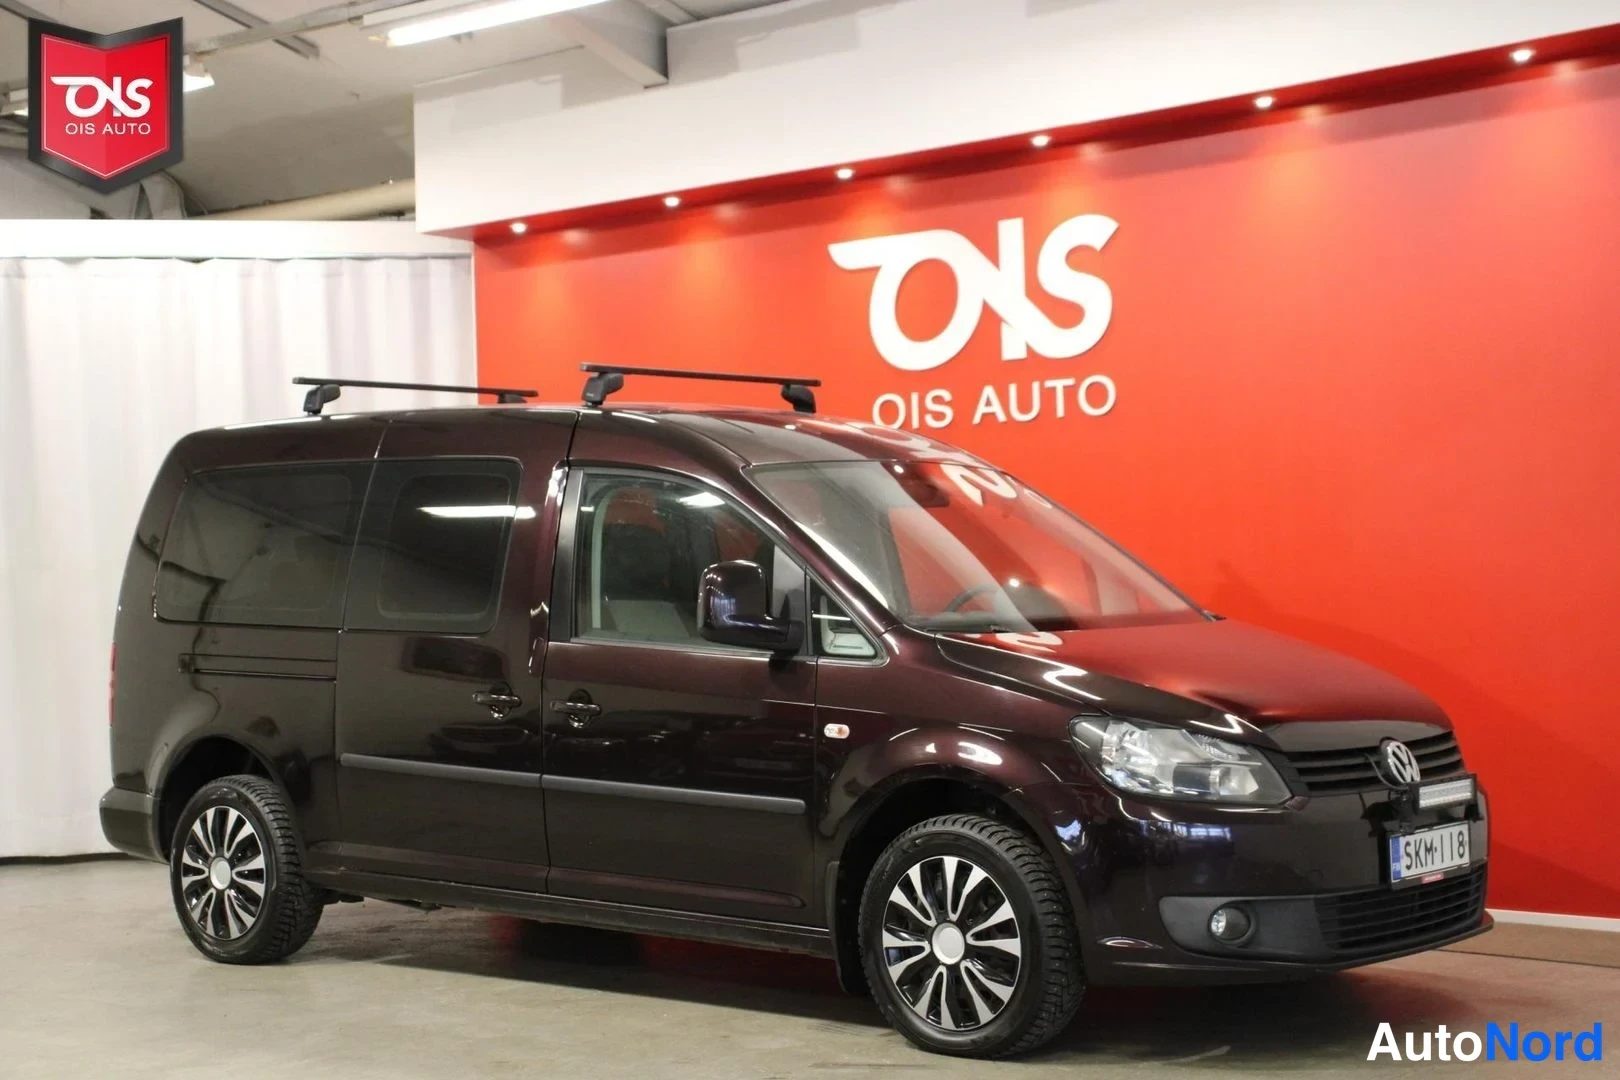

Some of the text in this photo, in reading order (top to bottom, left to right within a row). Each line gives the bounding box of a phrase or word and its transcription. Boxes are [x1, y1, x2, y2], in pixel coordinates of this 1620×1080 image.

[872, 375, 1117, 430] OIS AUTO
[1403, 830, 1466, 871] SKM-118
